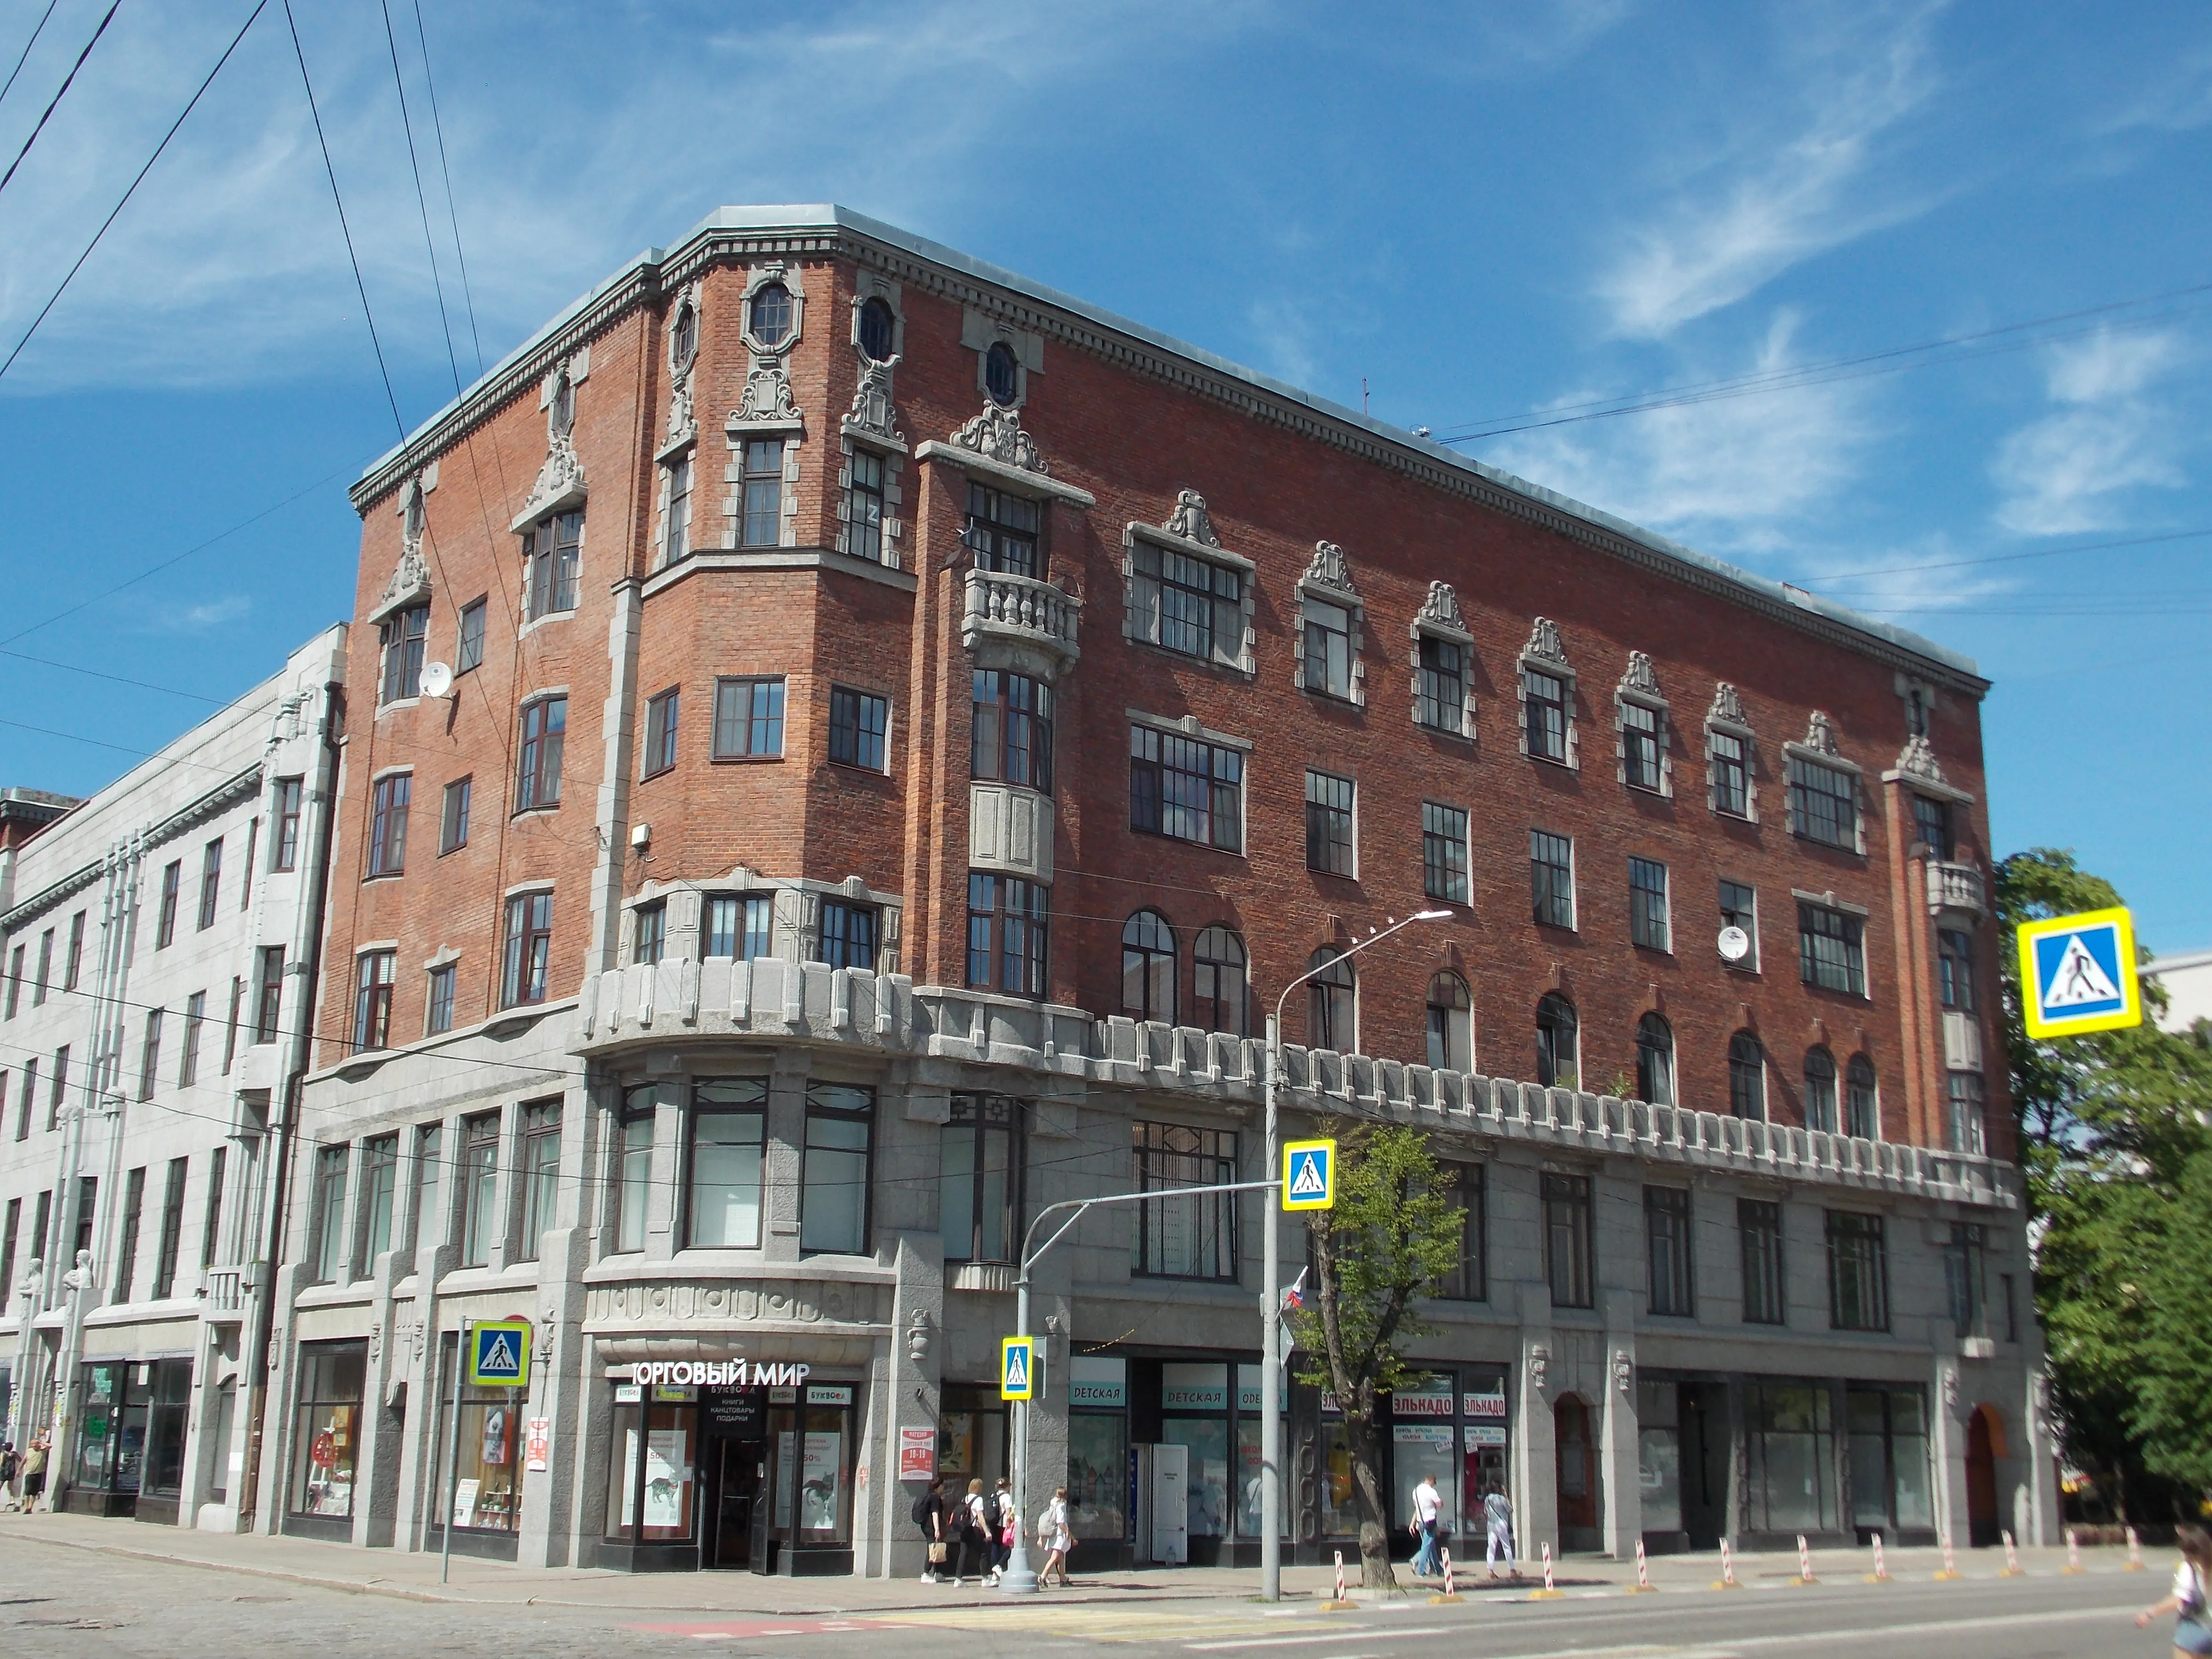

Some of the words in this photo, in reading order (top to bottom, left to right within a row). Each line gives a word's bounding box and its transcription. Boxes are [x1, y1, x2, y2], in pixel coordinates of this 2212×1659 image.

[632, 1358, 747, 1385] ТОРГОВЫЙ
[753, 1362, 810, 1386] МИР
[910, 1449, 926, 1458] 10-19
